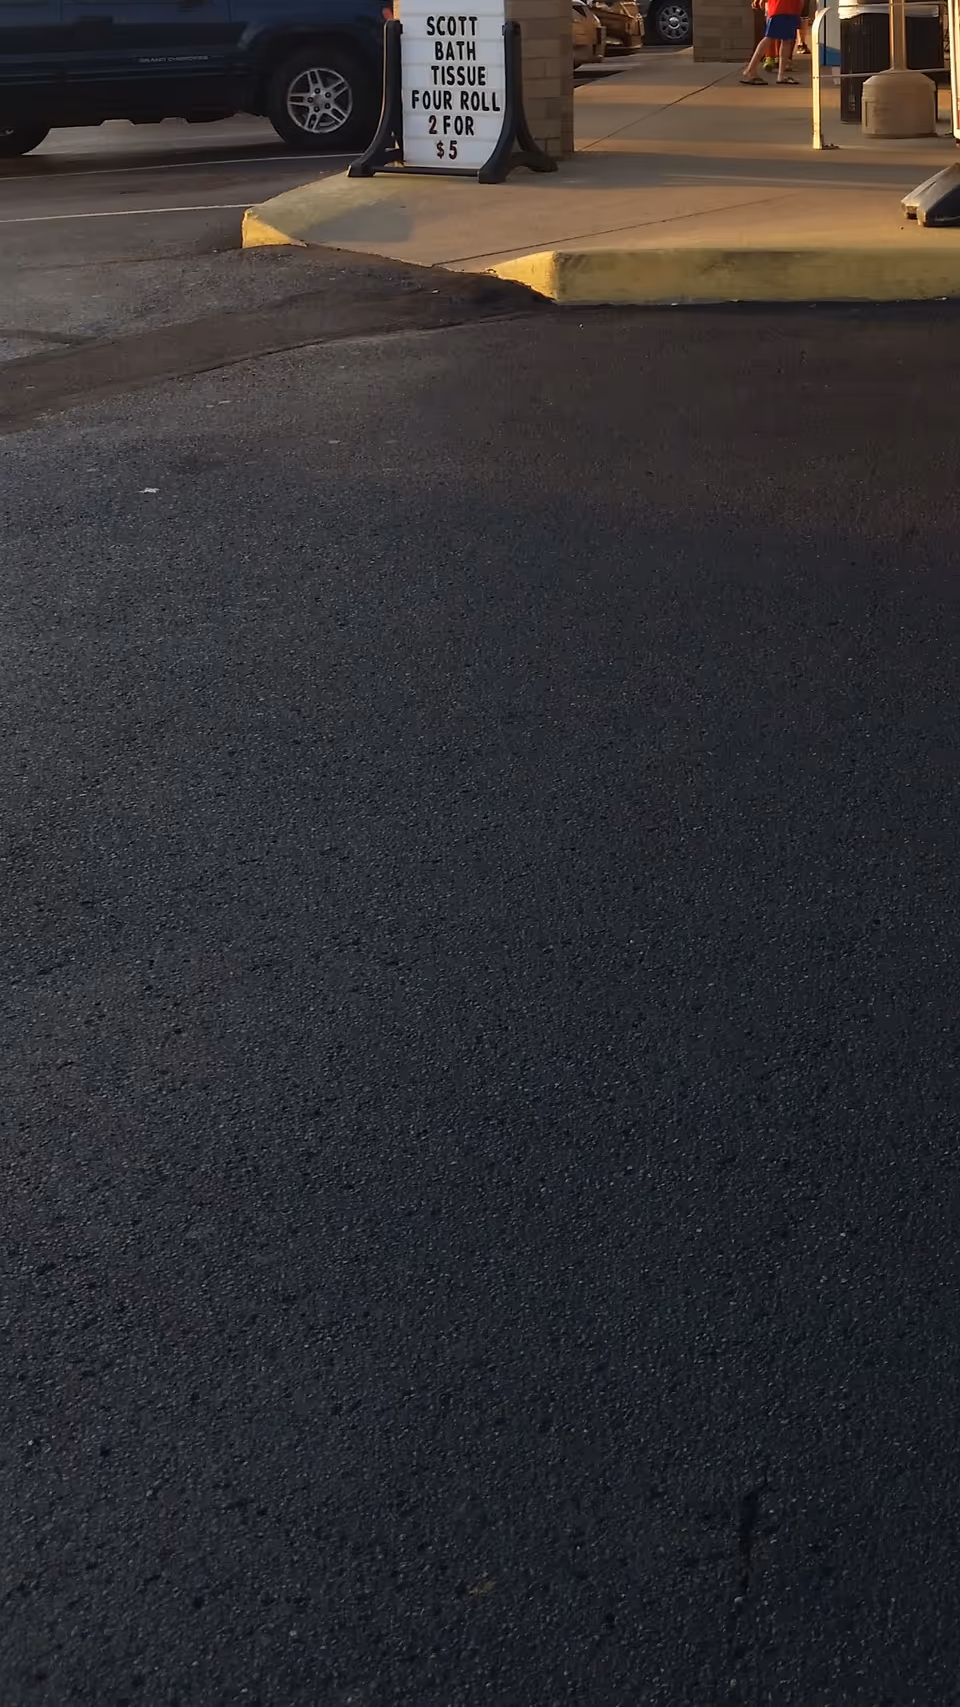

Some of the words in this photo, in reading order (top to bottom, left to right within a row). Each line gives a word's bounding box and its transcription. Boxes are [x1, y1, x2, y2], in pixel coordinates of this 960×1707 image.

[426, 16, 478, 36] SCOTT
[434, 41, 476, 61] BATH
[431, 65, 486, 86] TISSUE
[411, 90, 453, 110] FOUR
[460, 91, 501, 112] ROLL
[428, 115, 438, 135] 2
[443, 116, 475, 136] FOR
